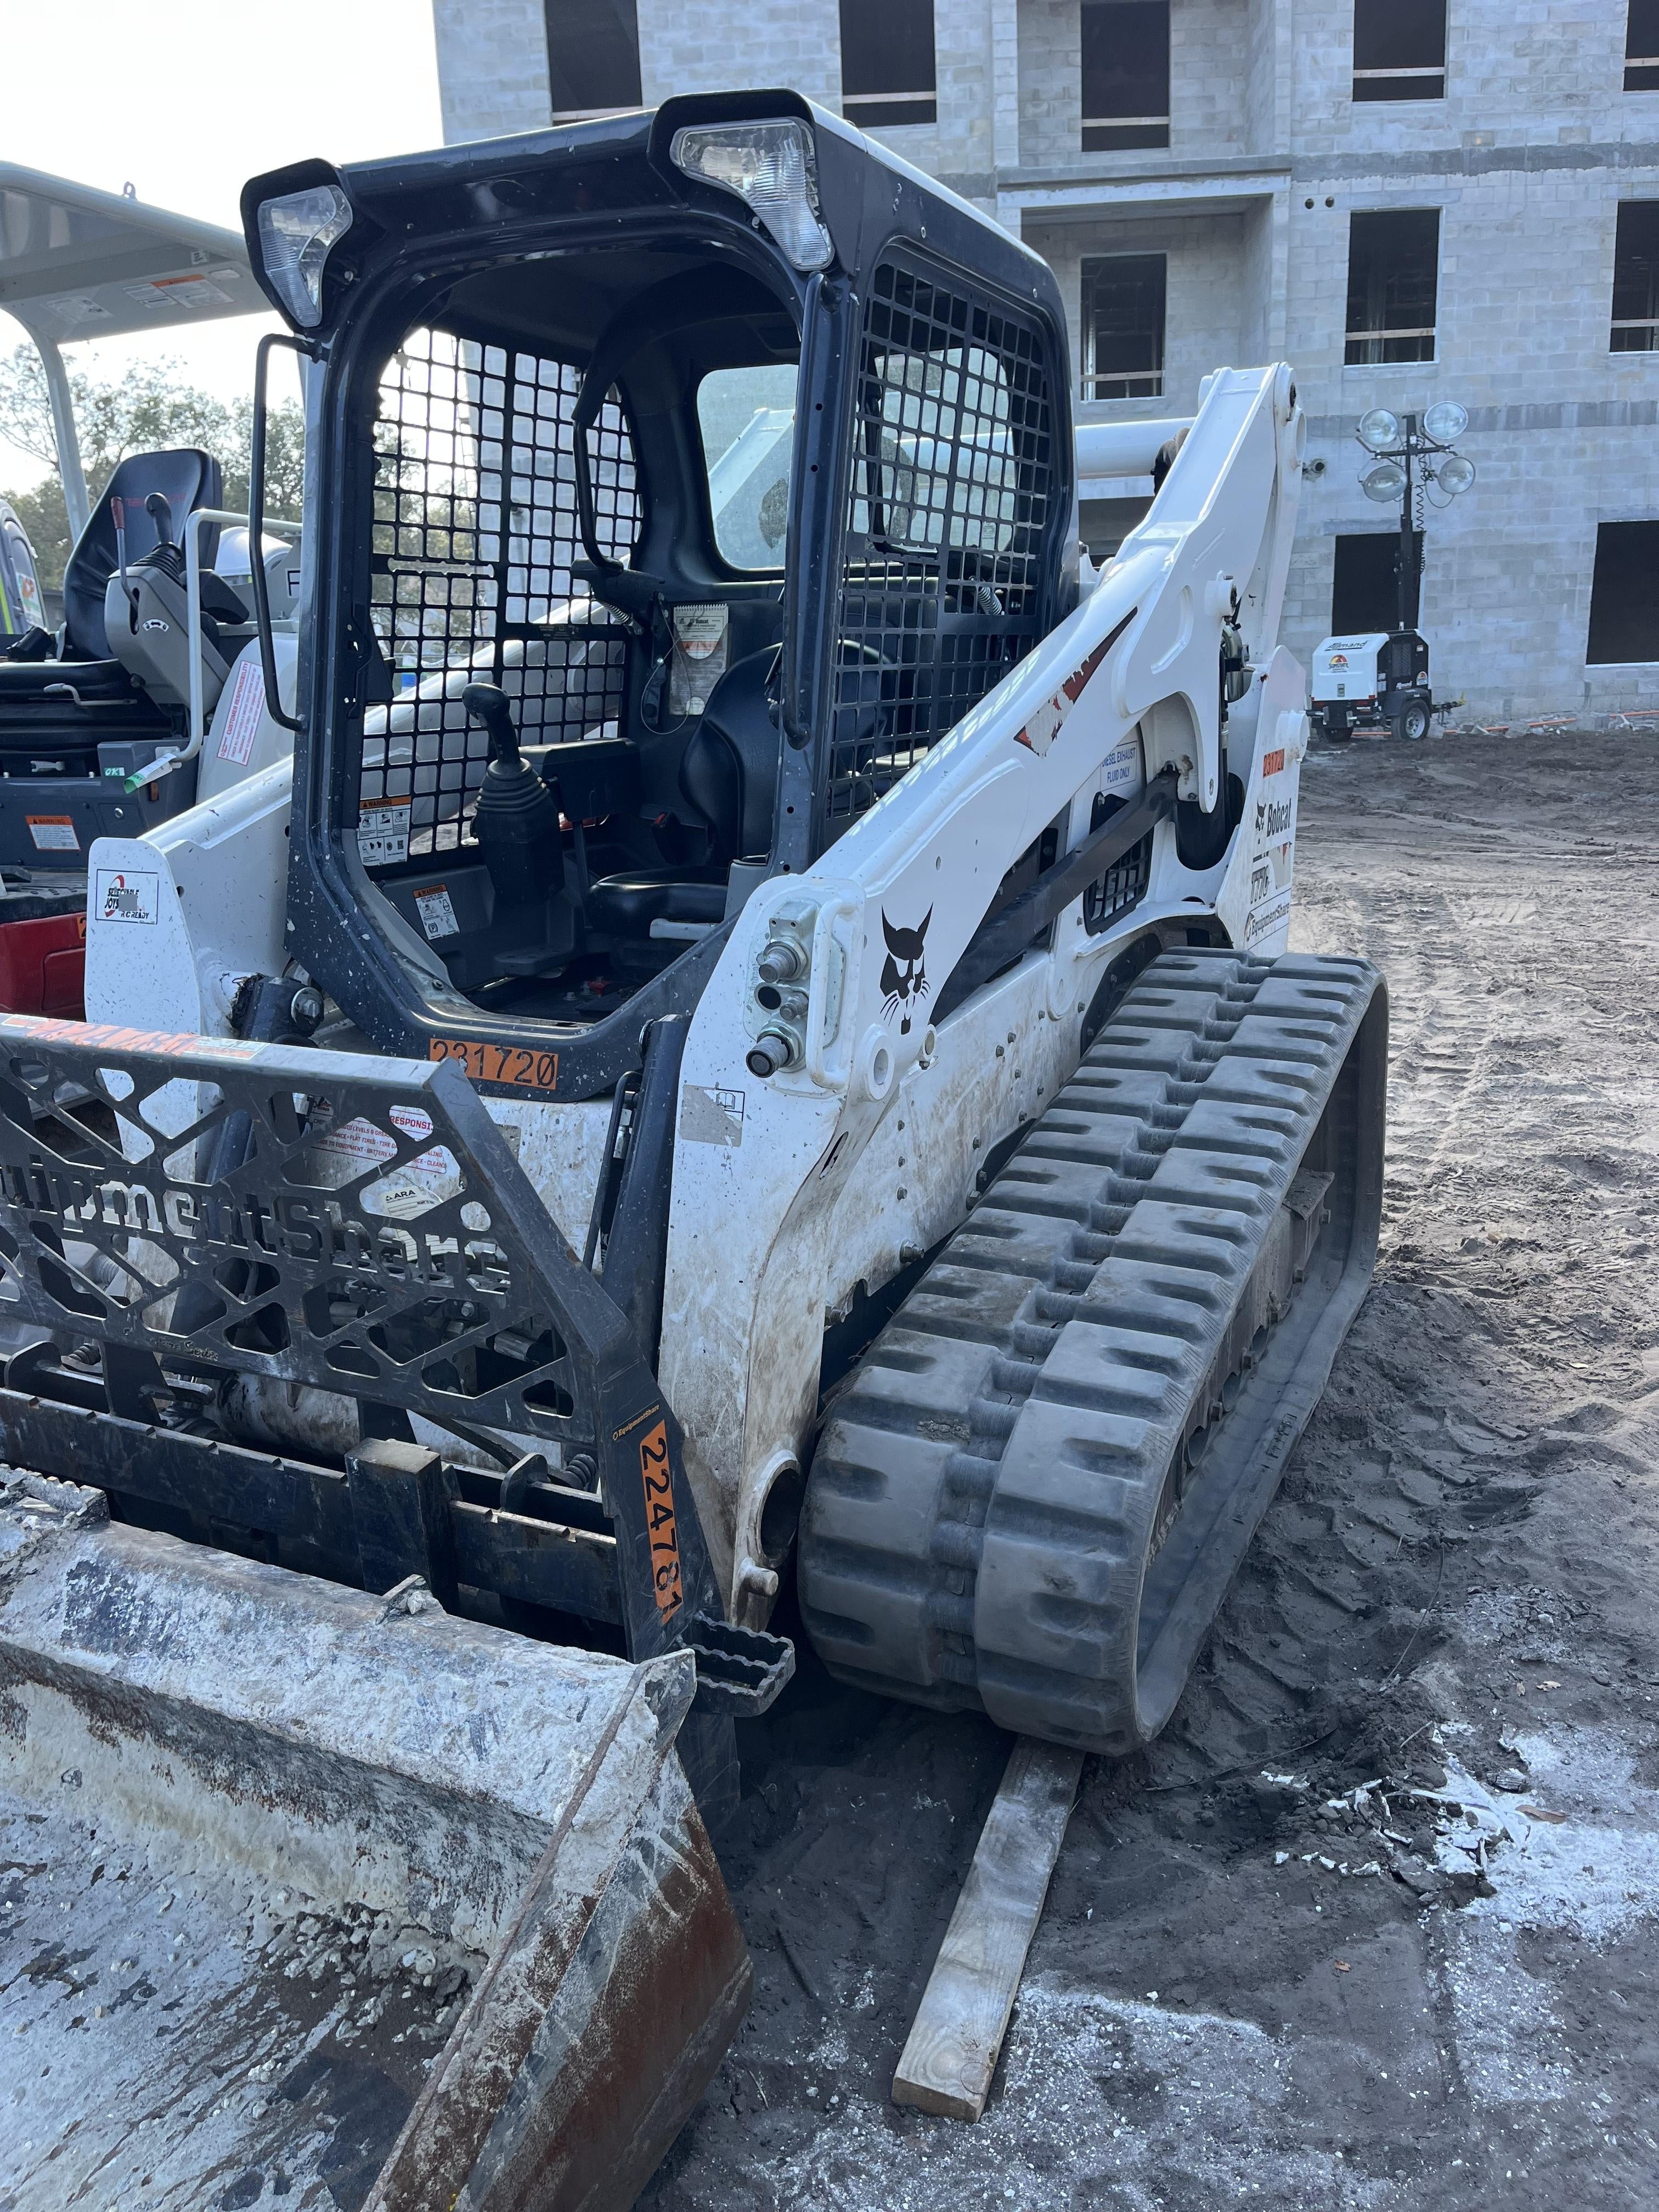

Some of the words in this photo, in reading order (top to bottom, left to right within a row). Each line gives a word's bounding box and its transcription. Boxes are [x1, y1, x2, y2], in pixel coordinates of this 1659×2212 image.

[227, 706, 238, 735] CUSTOMER
[1117, 747, 1136, 763] EXHAUST
[1107, 769, 1119, 783] FLUID
[1120, 766, 1130, 779] ONLY
[1267, 798, 1291, 838] Bobcat
[1251, 902, 1289, 936] EquipmentShare
[433, 1041, 555, 1086] 231720
[353, 1126, 370, 1134] LEVELS
[390, 1115, 433, 1130] RESPONSI
[336, 1142, 364, 1152] EQUIPMENT
[367, 1148, 387, 1156] BATTERY
[394, 1190, 416, 1199] ARA
[618, 1404, 659, 1436] EquipmentShare
[642, 1437, 683, 1615] 224781
